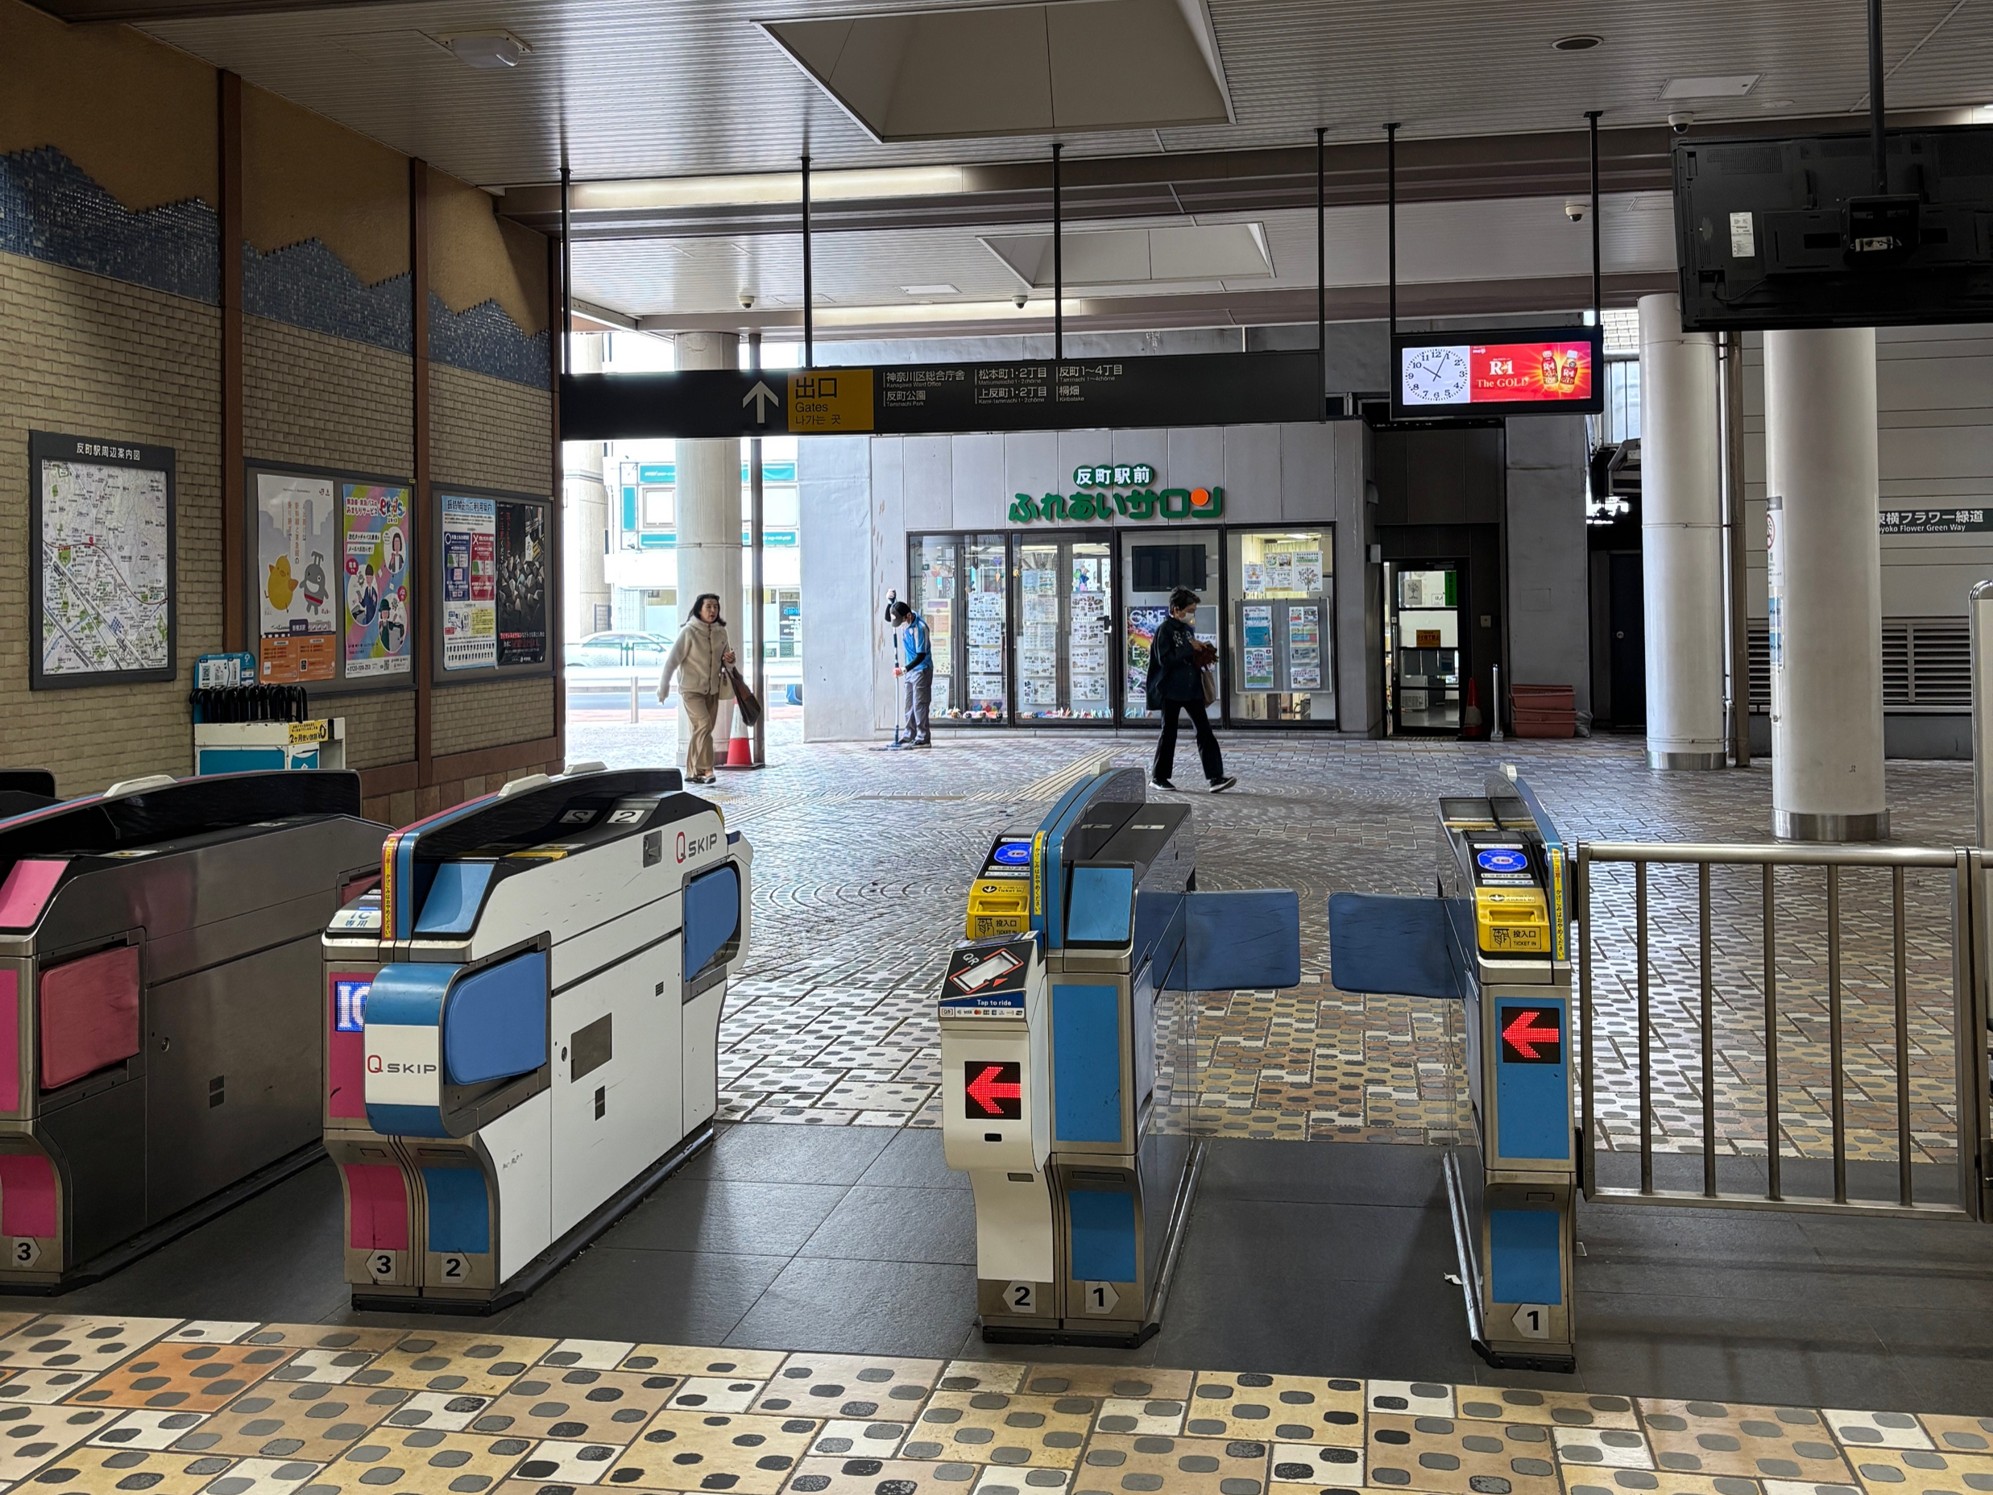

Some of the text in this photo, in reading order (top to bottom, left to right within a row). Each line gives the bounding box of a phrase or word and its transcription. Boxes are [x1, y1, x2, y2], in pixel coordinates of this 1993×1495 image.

[886, 370, 965, 382] 神奈川区総合庁舎
[1477, 376, 1529, 388] The GOLD
[795, 376, 837, 399] 出口
[887, 390, 926, 401] 反町公園
[795, 402, 829, 412] Gates
[795, 414, 841, 425] 나가는 곳
[76, 442, 141, 461] 反町駅周辺案内図
[1076, 467, 1151, 485] 反町駅前
[1008, 486, 1223, 522] ふれあいサロン
[1900, 525, 1924, 533] Flower
[1926, 524, 1948, 532] Green
[1949, 523, 1966, 532] Way
[688, 833, 718, 858] SKIP
[350, 911, 372, 919] IC
[996, 919, 1017, 927] 投入口
[1513, 930, 1537, 938] 投入口
[962, 952, 980, 966] QR
[976, 999, 988, 1007] Tap
[387, 1063, 437, 1074] SKIP
[17, 1242, 31, 1261] 3
[376, 1254, 391, 1274] 3
[445, 1258, 461, 1278] 2
[1014, 1286, 1031, 1307] 2
[1093, 1287, 1104, 1307] 1
[1526, 1310, 1539, 1331] 1
